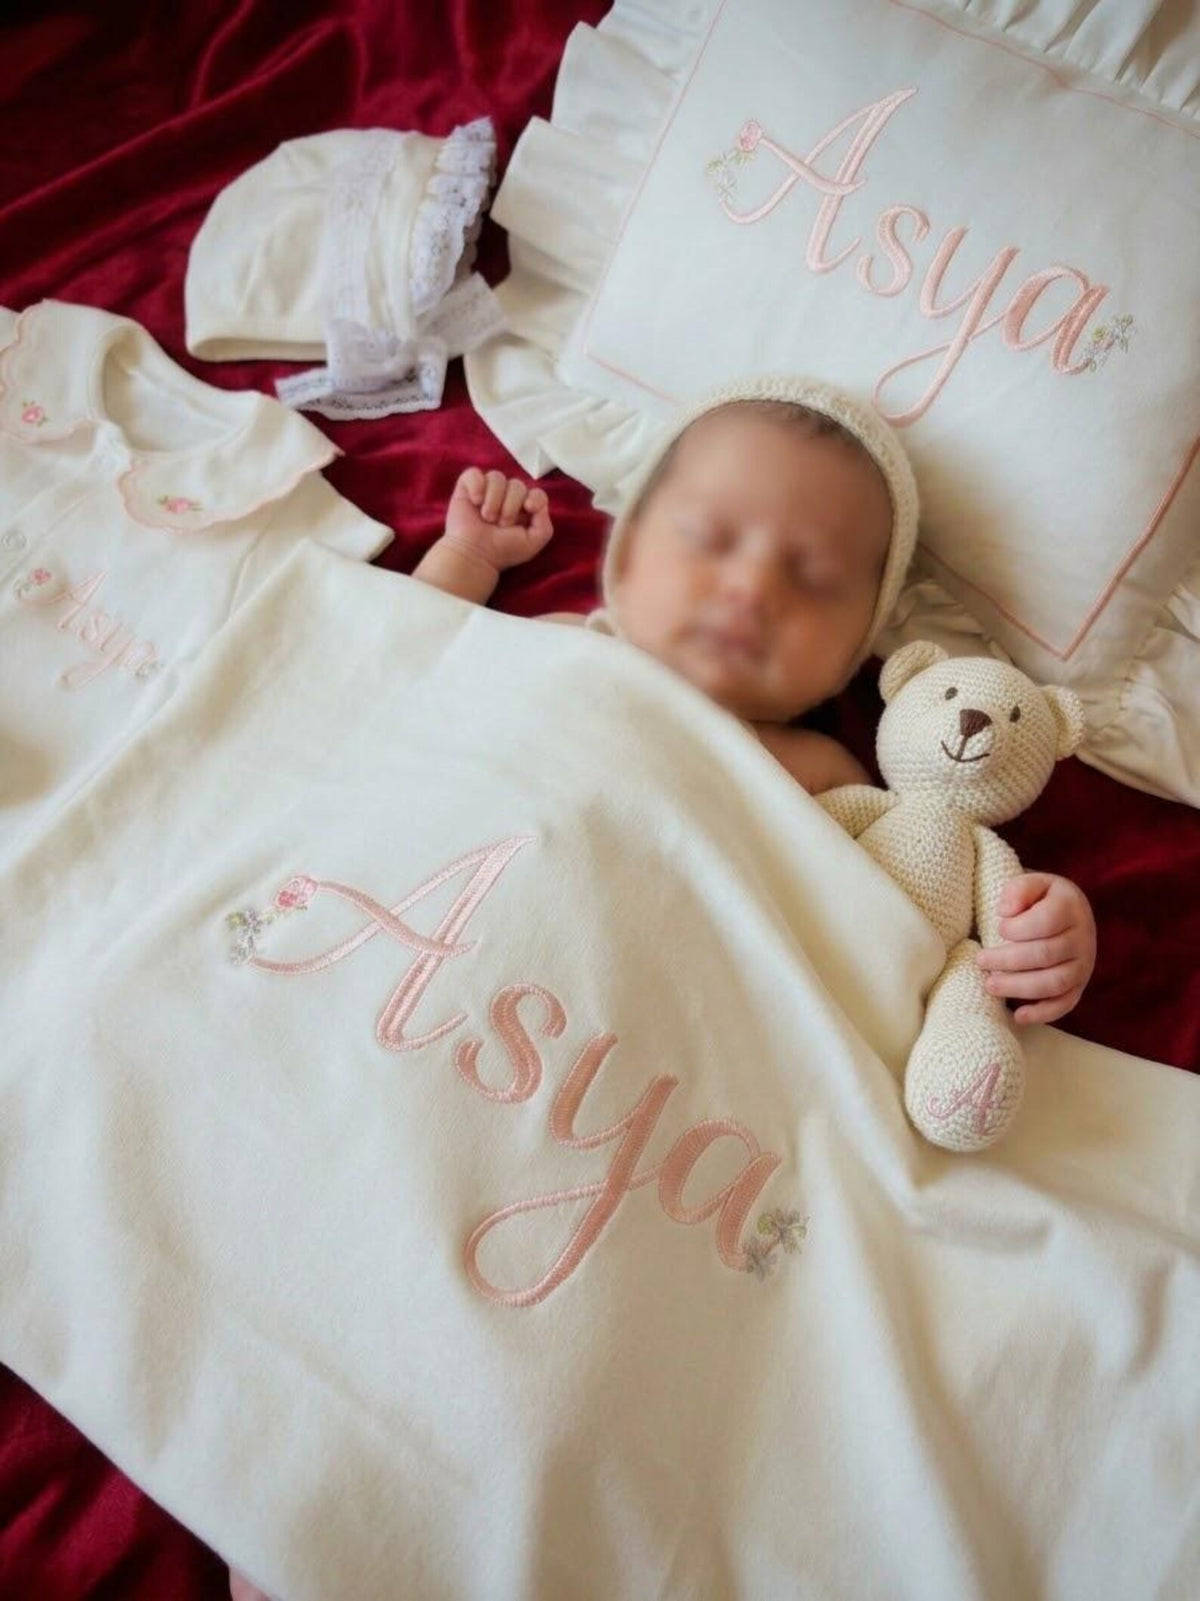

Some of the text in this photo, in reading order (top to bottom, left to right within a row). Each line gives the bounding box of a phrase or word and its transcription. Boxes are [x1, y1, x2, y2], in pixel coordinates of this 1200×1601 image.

[719, 86, 1110, 428] Asya
[18, 568, 158, 692] Asya
[249, 835, 782, 1308] Asya
[926, 1061, 1005, 1137] A
